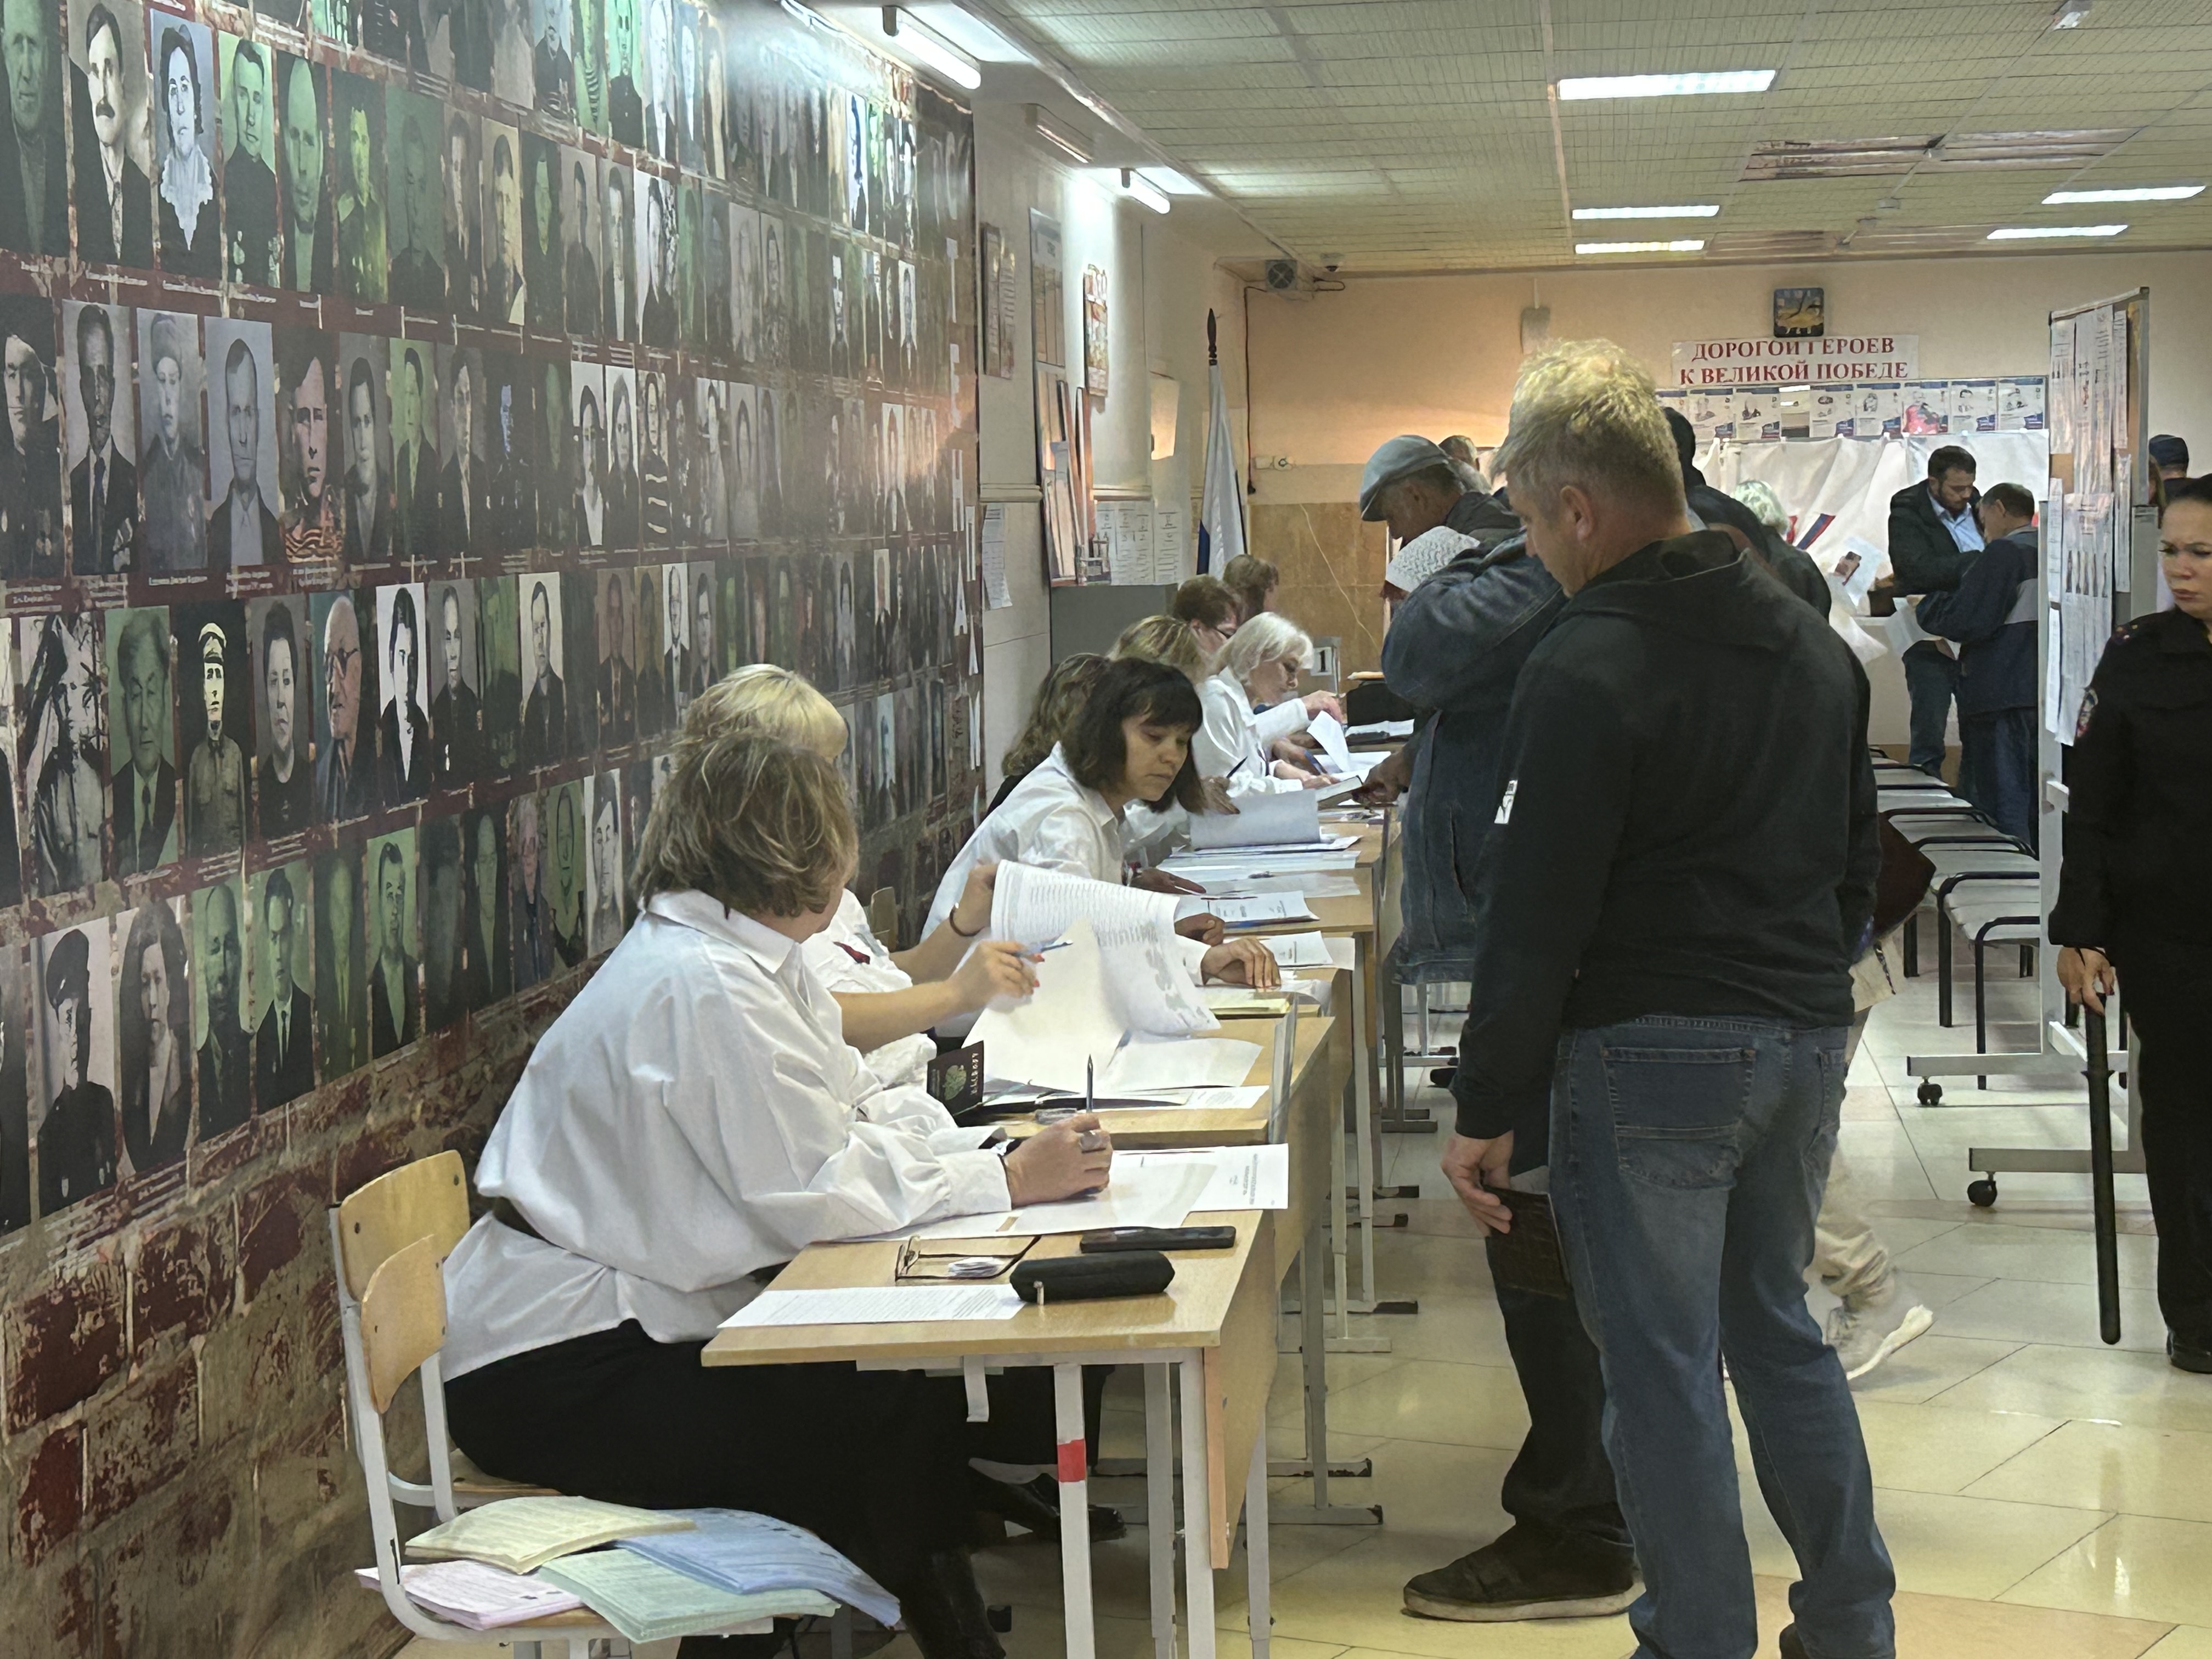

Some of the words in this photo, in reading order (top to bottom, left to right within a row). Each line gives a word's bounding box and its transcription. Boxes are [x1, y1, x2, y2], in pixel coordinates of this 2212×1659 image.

[1680, 369, 1695, 385] К
[1701, 359, 1809, 384] ВЕЛИКОЙ
[1817, 362, 1908, 380] ПОБЕДЕ
[1317, 650, 1328, 673] 1
